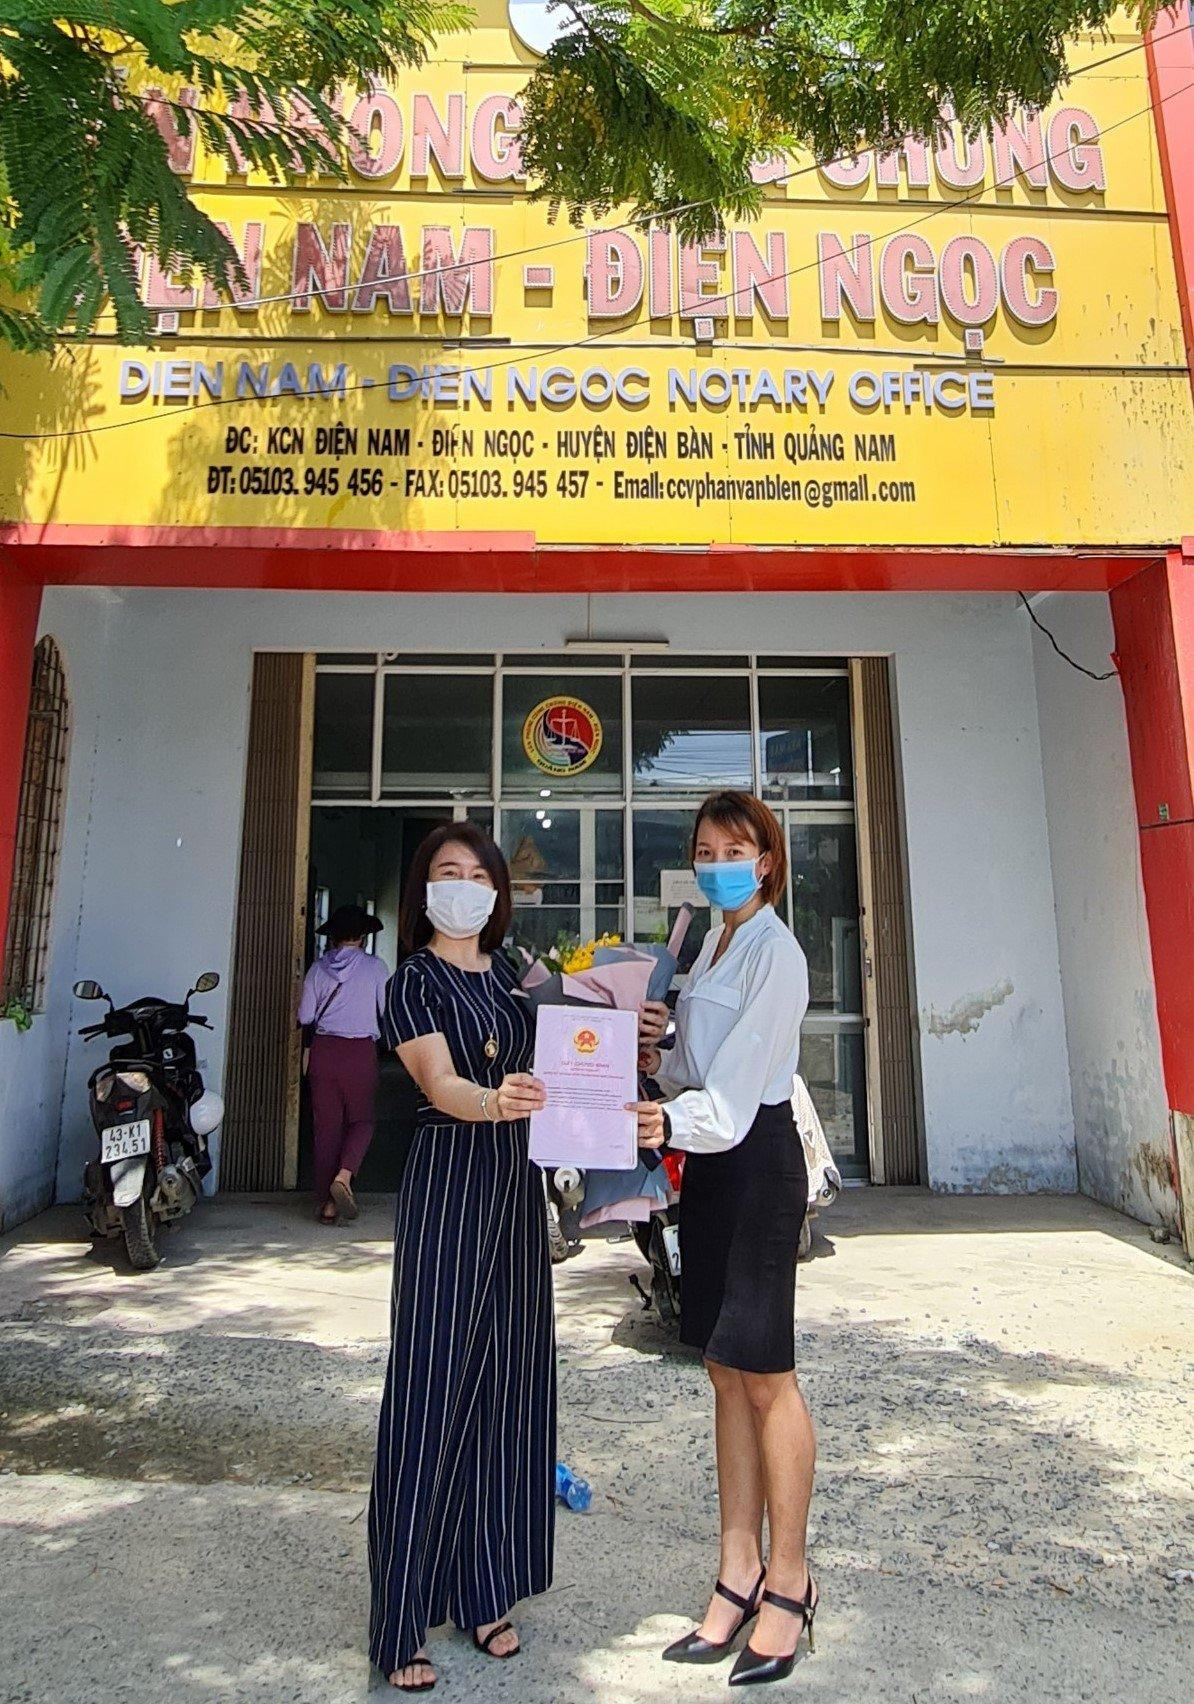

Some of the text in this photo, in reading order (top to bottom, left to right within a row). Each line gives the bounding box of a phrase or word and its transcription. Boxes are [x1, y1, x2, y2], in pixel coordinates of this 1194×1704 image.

[292, 222, 495, 315] NAM
[817, 232, 1058, 352] NGỌC
[119, 360, 223, 399] DIEN
[236, 361, 348, 399] NAM
[388, 364, 492, 401] DIEN
[506, 366, 649, 403] NGOC
[668, 369, 835, 406] NOTARY
[848, 371, 996, 409] OFFICE
[225, 426, 258, 456] ĐC:
[267, 427, 304, 456] KCN
[315, 421, 358, 461] ĐIỆN
[367, 428, 411, 456] NAM
[484, 429, 534, 463] NGỌC
[557, 425, 616, 463] HUYỆN
[626, 425, 667, 463] ĐIỆN
[678, 426, 713, 459] BÀN
[734, 423, 775, 459] TỈNH
[784, 424, 845, 461] QUẢNG
[855, 434, 896, 461] NAM
[347, 469, 383, 495] 456
[556, 471, 589, 498] 457
